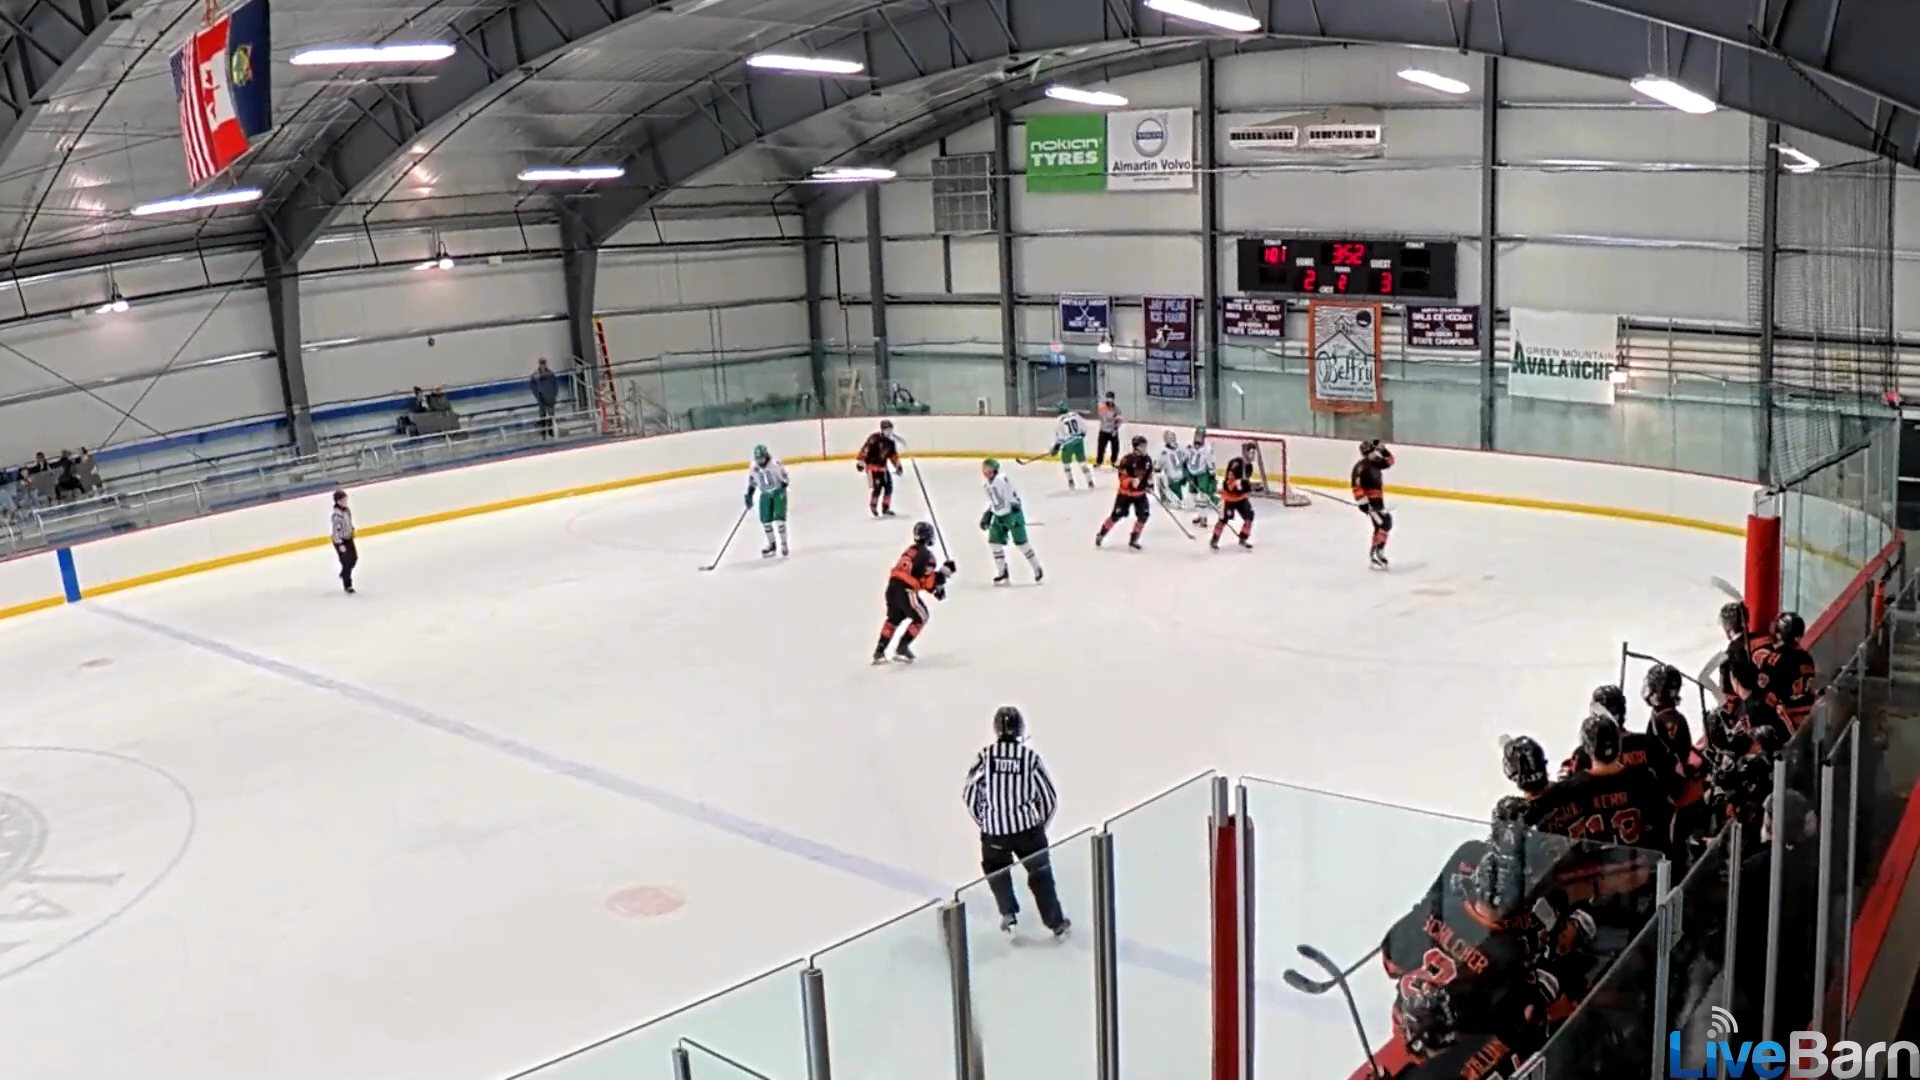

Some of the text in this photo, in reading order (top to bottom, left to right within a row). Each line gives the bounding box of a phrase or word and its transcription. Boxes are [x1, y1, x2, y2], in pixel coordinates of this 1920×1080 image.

[1030, 151, 1099, 167] TYRES
[1112, 158, 1191, 172] Almartin Volvo
[1303, 268, 1316, 291] 2
[1381, 271, 1393, 293] 3
[1165, 300, 1188, 312] PEAK
[1255, 304, 1281, 313] HOCKEY
[1433, 313, 1444, 321] ICE
[1444, 313, 1473, 322] HOCKEY
[1226, 326, 1281, 337] STATE CHAMPIONS
[1411, 336, 1475, 347] STATE CHAMPIONS
[1525, 346, 1617, 361] GREEN MOUNTAIN
